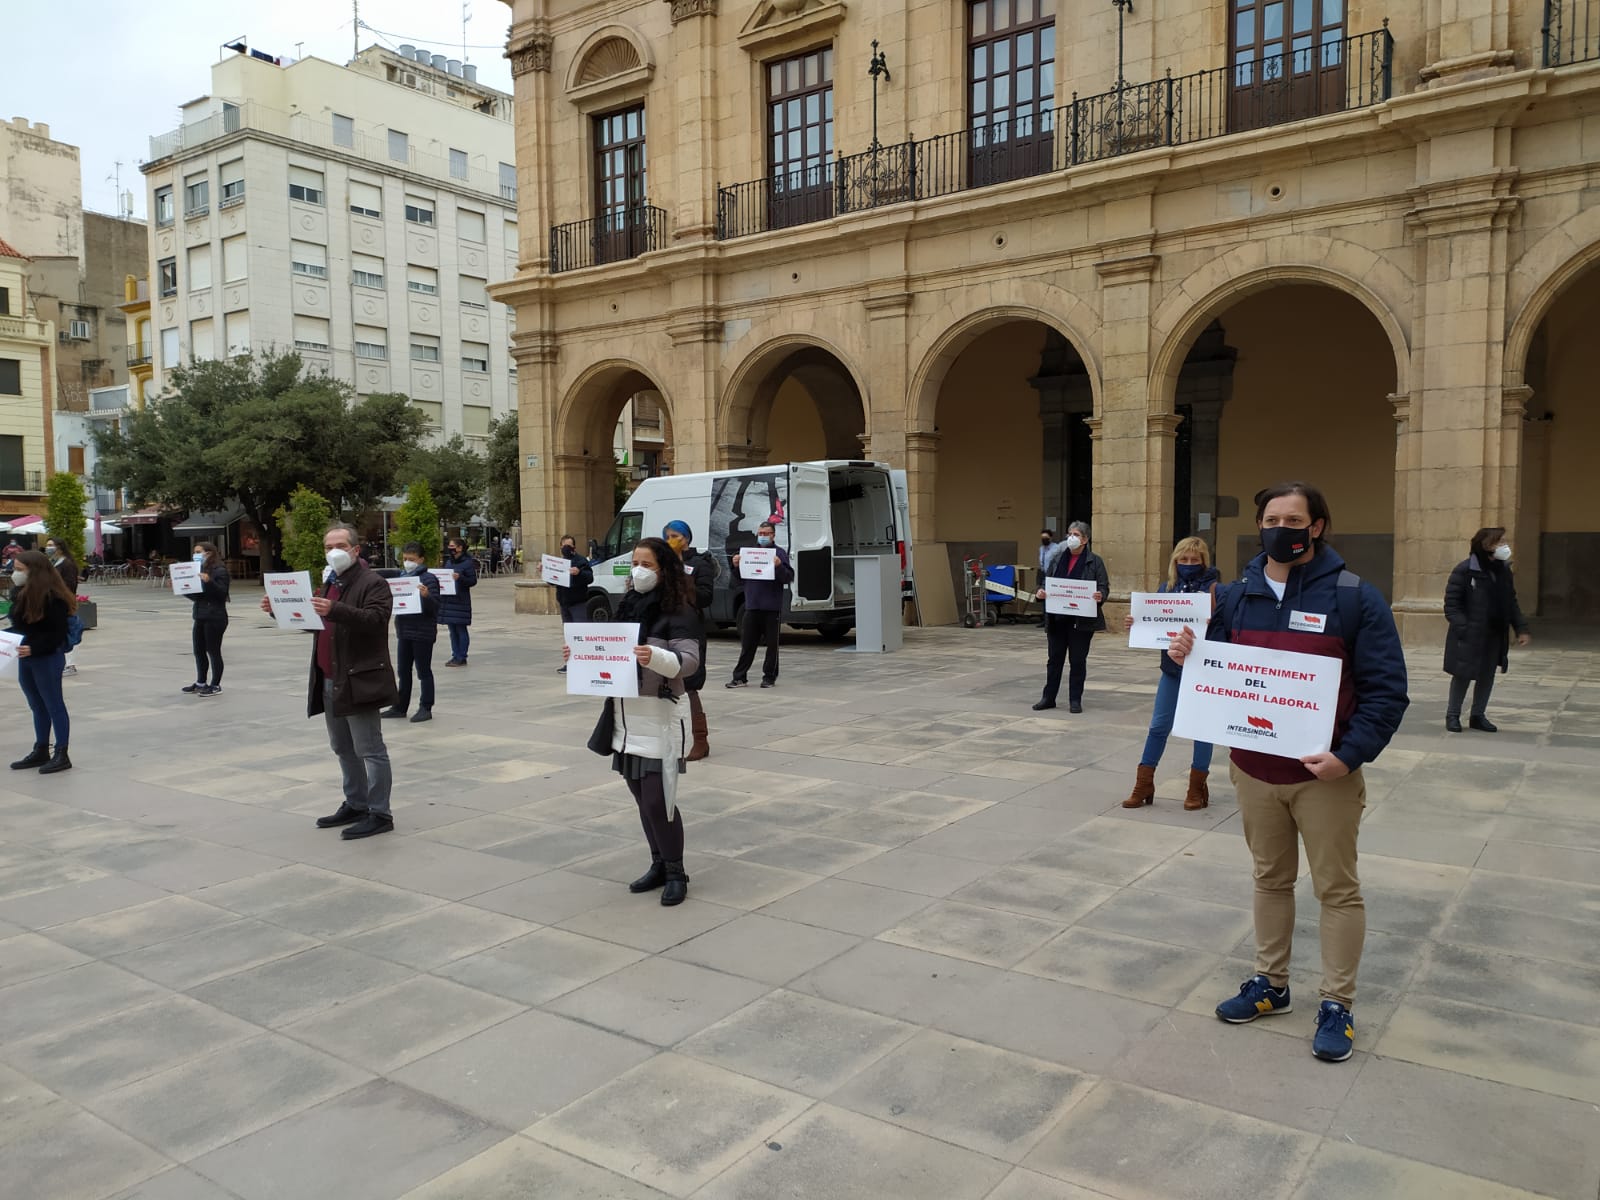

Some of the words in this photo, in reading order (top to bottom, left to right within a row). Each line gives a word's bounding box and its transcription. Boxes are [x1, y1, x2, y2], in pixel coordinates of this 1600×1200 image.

[1203, 658, 1224, 669] PEL
[1227, 661, 1317, 682] MANTENIMENT
[1244, 678, 1267, 689] DEL
[1195, 684, 1260, 702] CALENDARI
[1263, 695, 1320, 711] LABORAL
[1226, 724, 1279, 739] INTERSINDICAL
